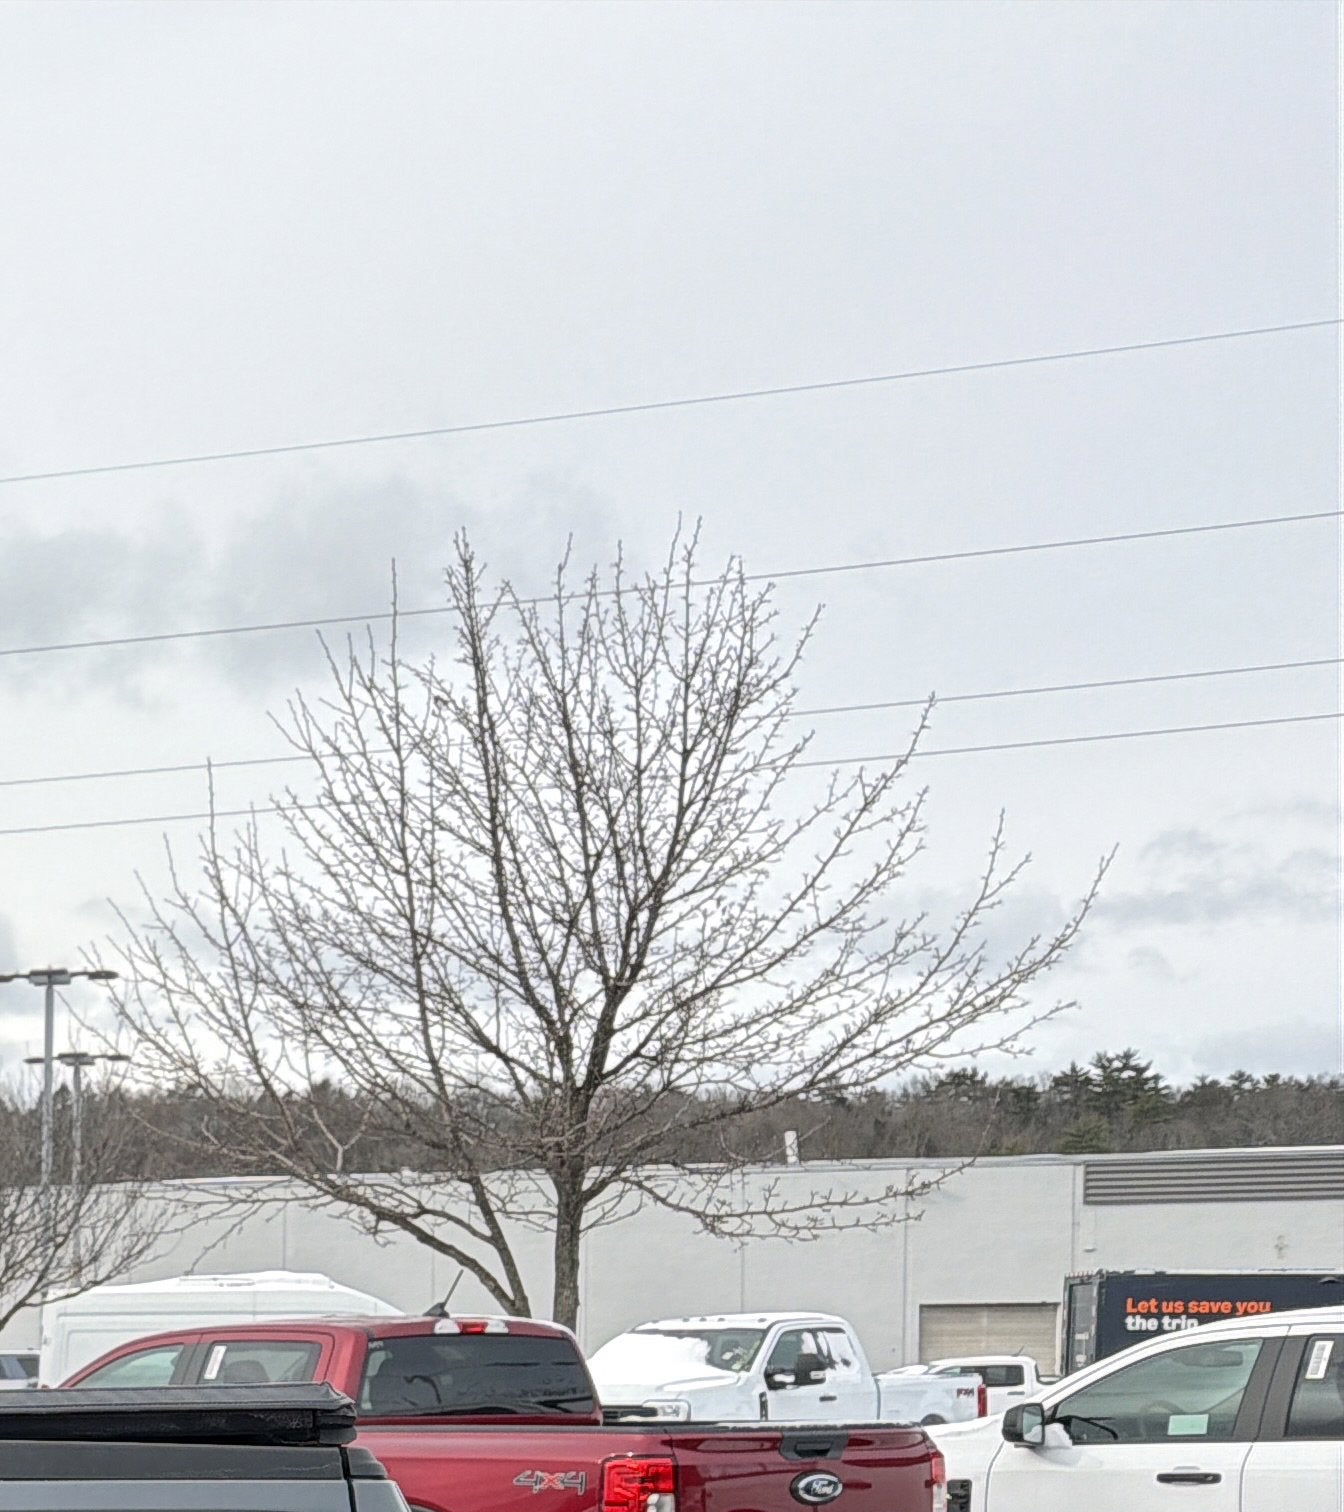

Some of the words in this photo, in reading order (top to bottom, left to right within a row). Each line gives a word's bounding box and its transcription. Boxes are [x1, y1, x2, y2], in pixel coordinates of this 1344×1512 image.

[1126, 1298, 1159, 1314] Let
[1162, 1301, 1185, 1314] us
[1188, 1301, 1233, 1314] save
[1235, 1301, 1272, 1316] you
[1125, 1315, 1159, 1331] the
